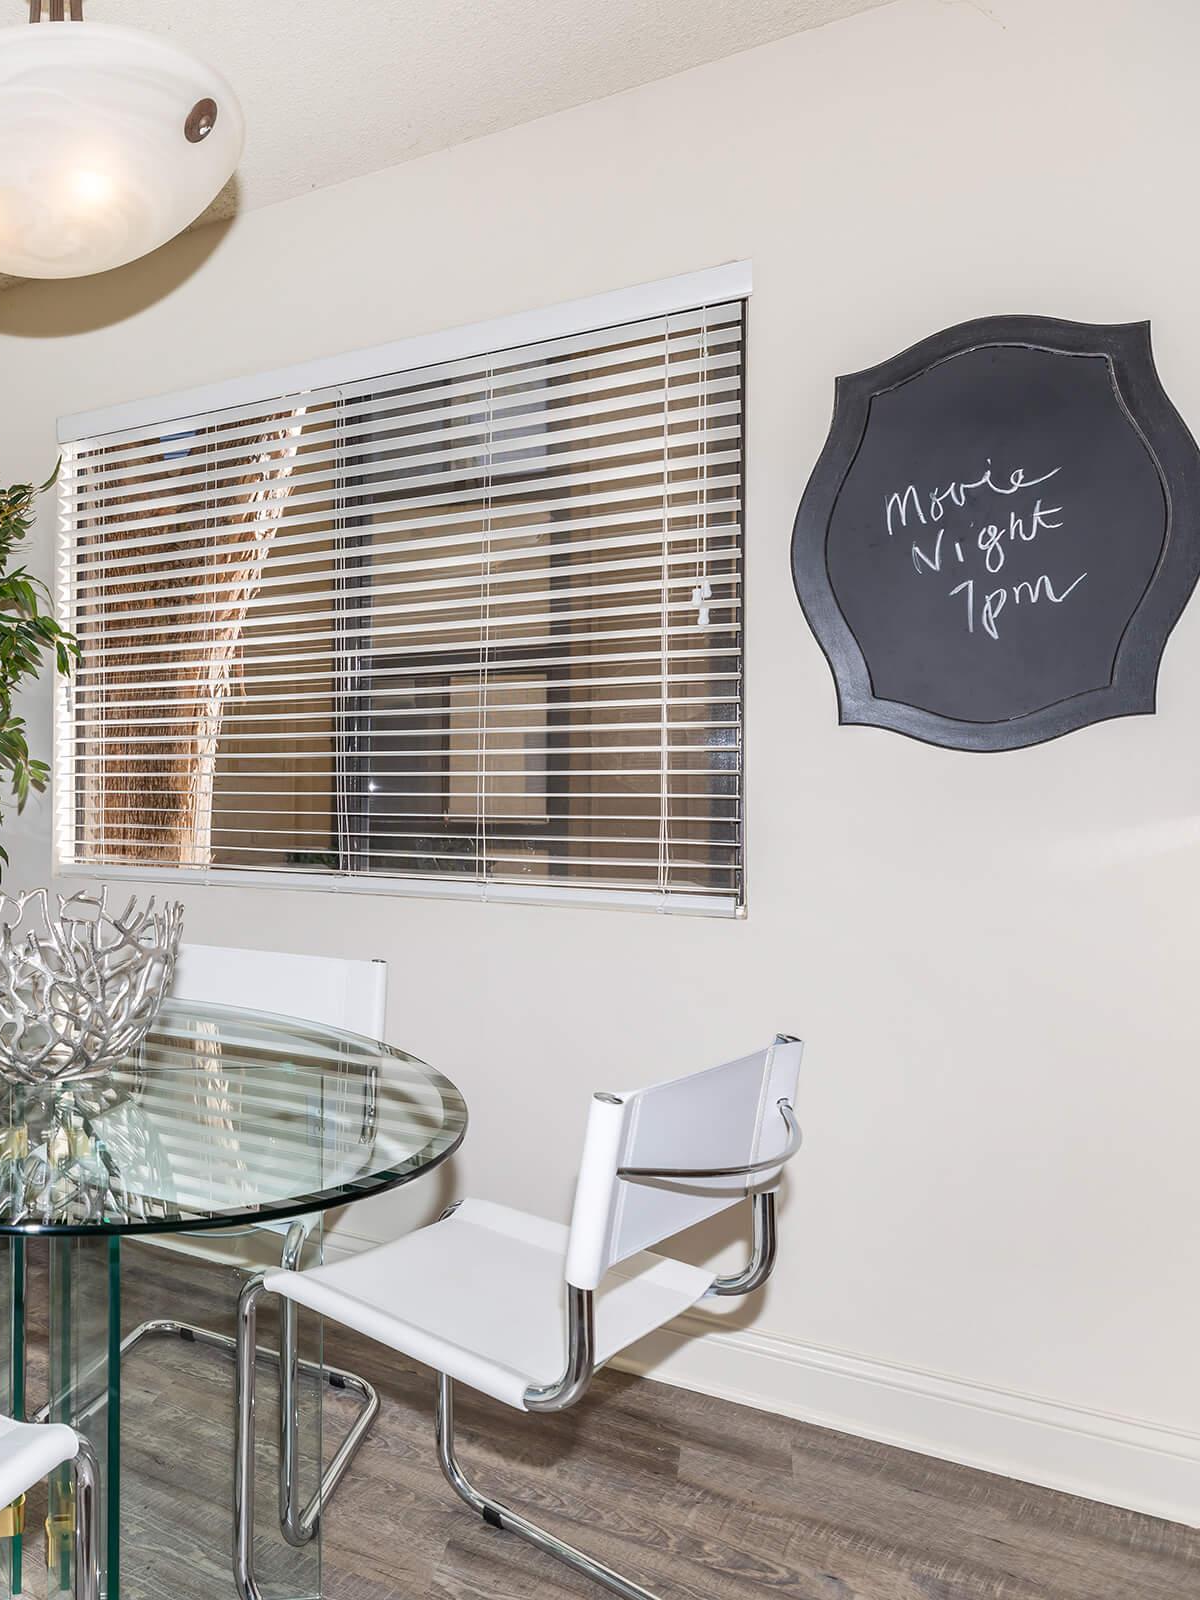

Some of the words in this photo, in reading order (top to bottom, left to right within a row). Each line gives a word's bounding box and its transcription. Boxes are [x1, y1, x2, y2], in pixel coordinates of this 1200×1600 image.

[885, 458, 1062, 535] Movie
[912, 499, 1063, 574] Night
[949, 572, 1087, 640] 7pm
